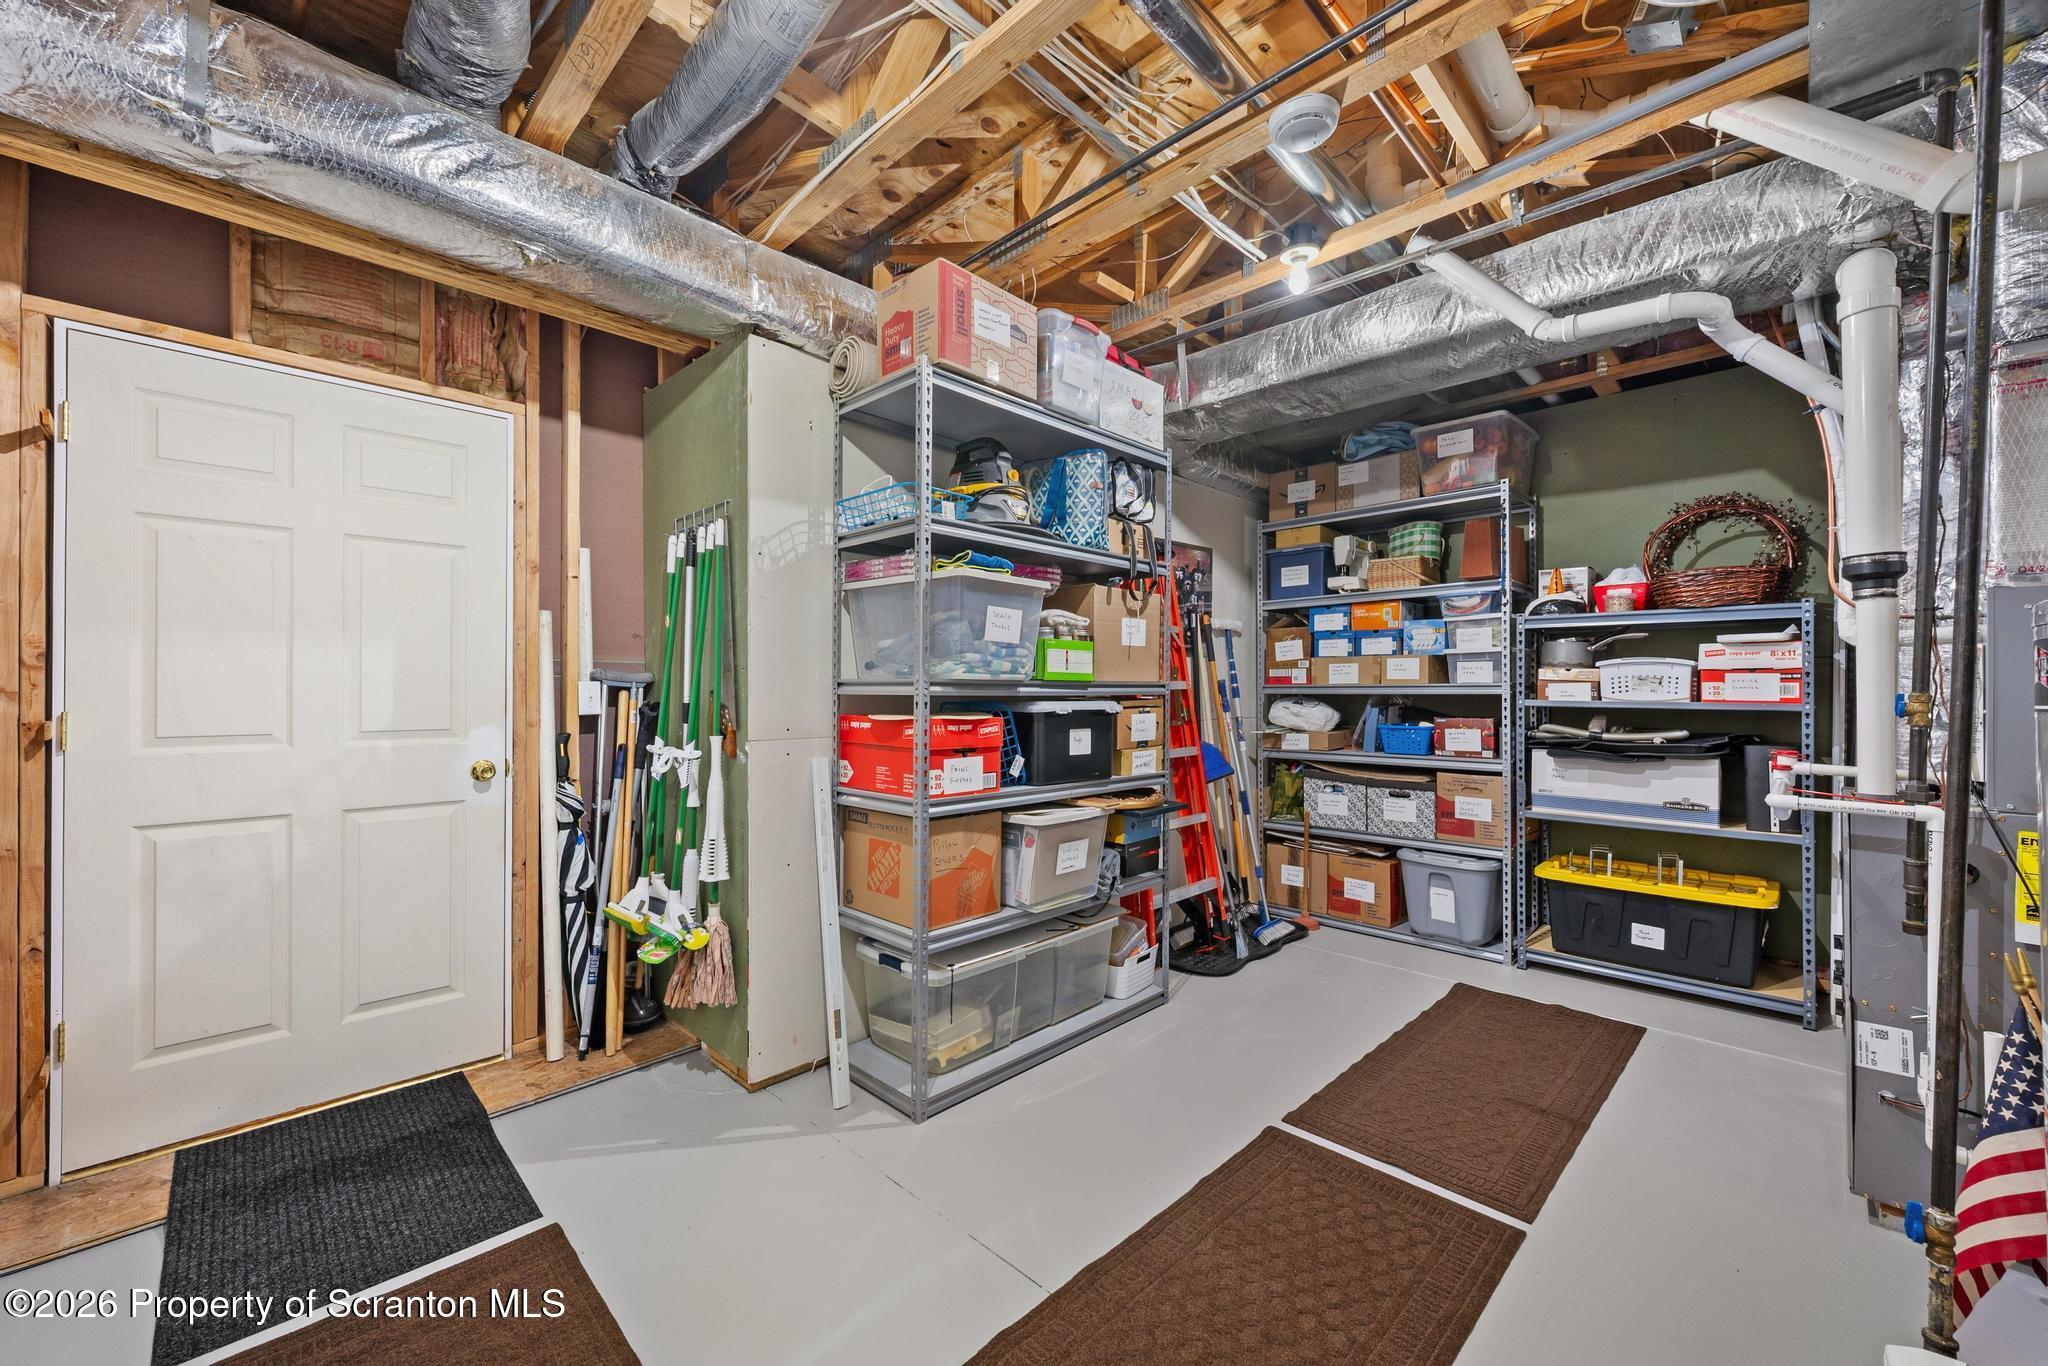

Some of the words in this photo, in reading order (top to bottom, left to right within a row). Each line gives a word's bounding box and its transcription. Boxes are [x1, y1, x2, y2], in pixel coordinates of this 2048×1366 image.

[956, 289, 968, 337] small
[885, 321, 905, 336] Heavy
[885, 335, 900, 346] Duty
[1787, 649, 1797, 657] 11
[850, 721, 861, 729] copy
[860, 721, 873, 729] paper
[947, 724, 958, 732] copy
[959, 723, 973, 731] paper
[979, 725, 1000, 735] STAPLES
[934, 773, 942, 781] 92
[868, 843, 901, 890] HOME
